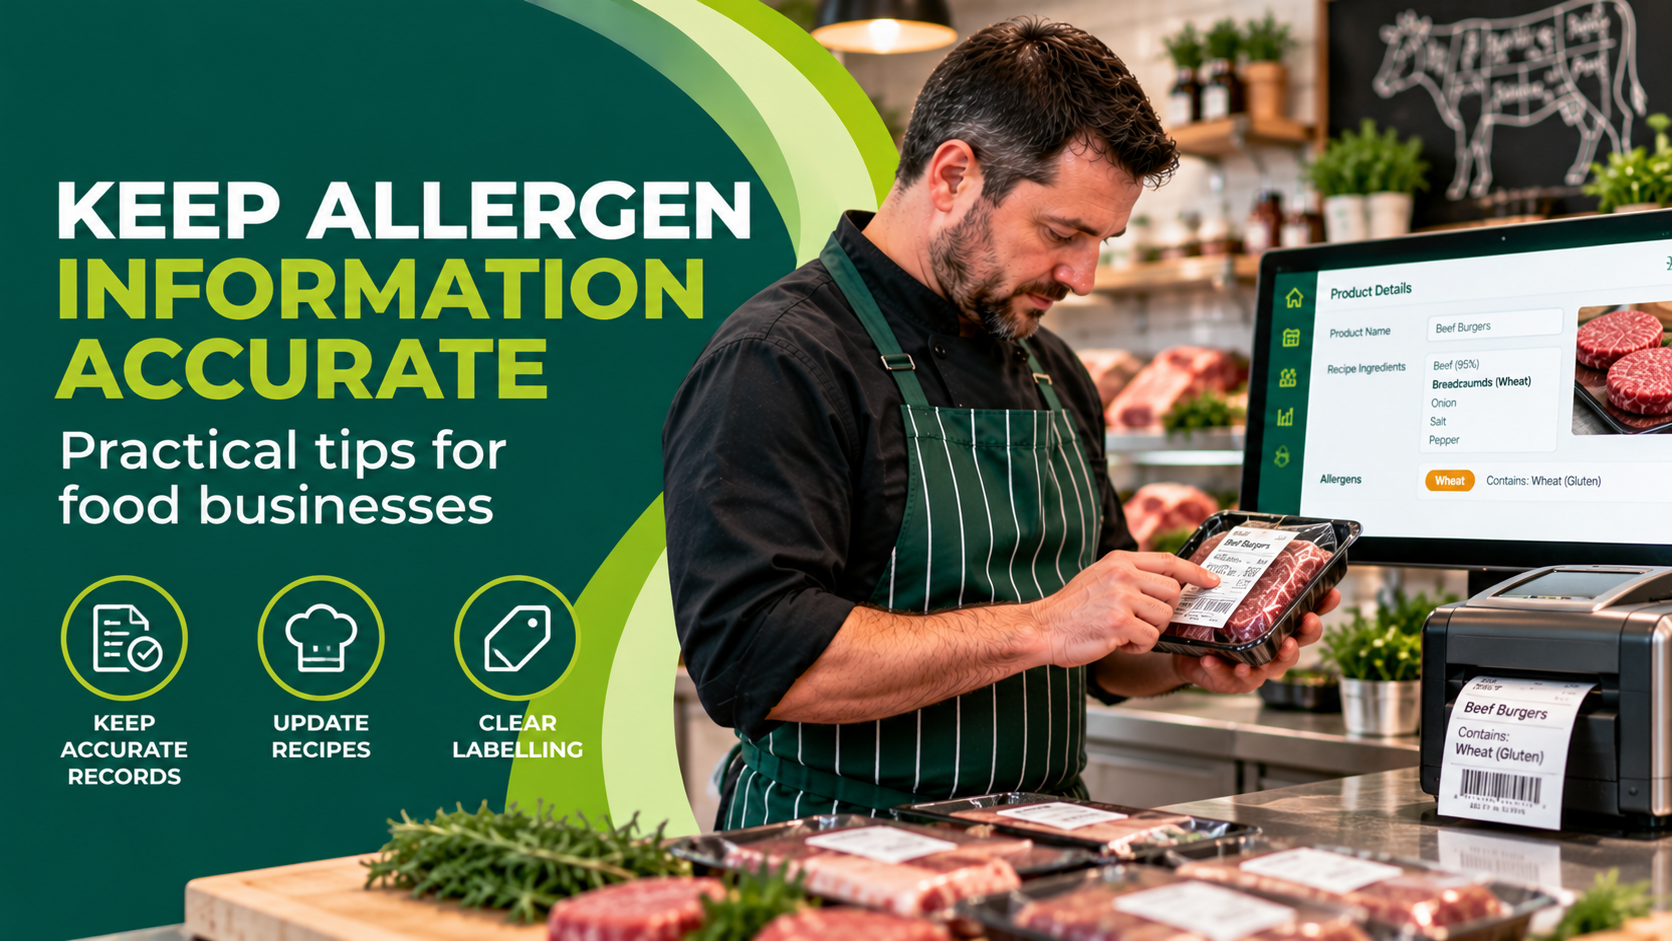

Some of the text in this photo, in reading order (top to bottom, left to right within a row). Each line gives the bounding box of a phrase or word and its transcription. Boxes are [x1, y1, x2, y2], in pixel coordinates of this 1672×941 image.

[1331, 282, 1412, 299] Product Details
[1330, 327, 1391, 338] Product Name
[1436, 322, 1491, 333] Beef Burgers
[1328, 363, 1406, 375] Recipe Ingredients
[1434, 359, 1479, 371] Beef (95%)
[1496, 376, 1531, 388] (Wheat)
[1431, 398, 1456, 408] Onion
[1430, 417, 1446, 426] Salt
[1429, 435, 1460, 446] Pepper
[1320, 474, 1362, 486] Allergens
[1435, 476, 1465, 485] Wheat
[1487, 475, 1601, 487] Contains: Wheat (Gluten)
[1464, 701, 1548, 721] Beef Burgers
[1458, 726, 1510, 743] Contains:
[1456, 743, 1544, 765] Wheat (Gluten)
